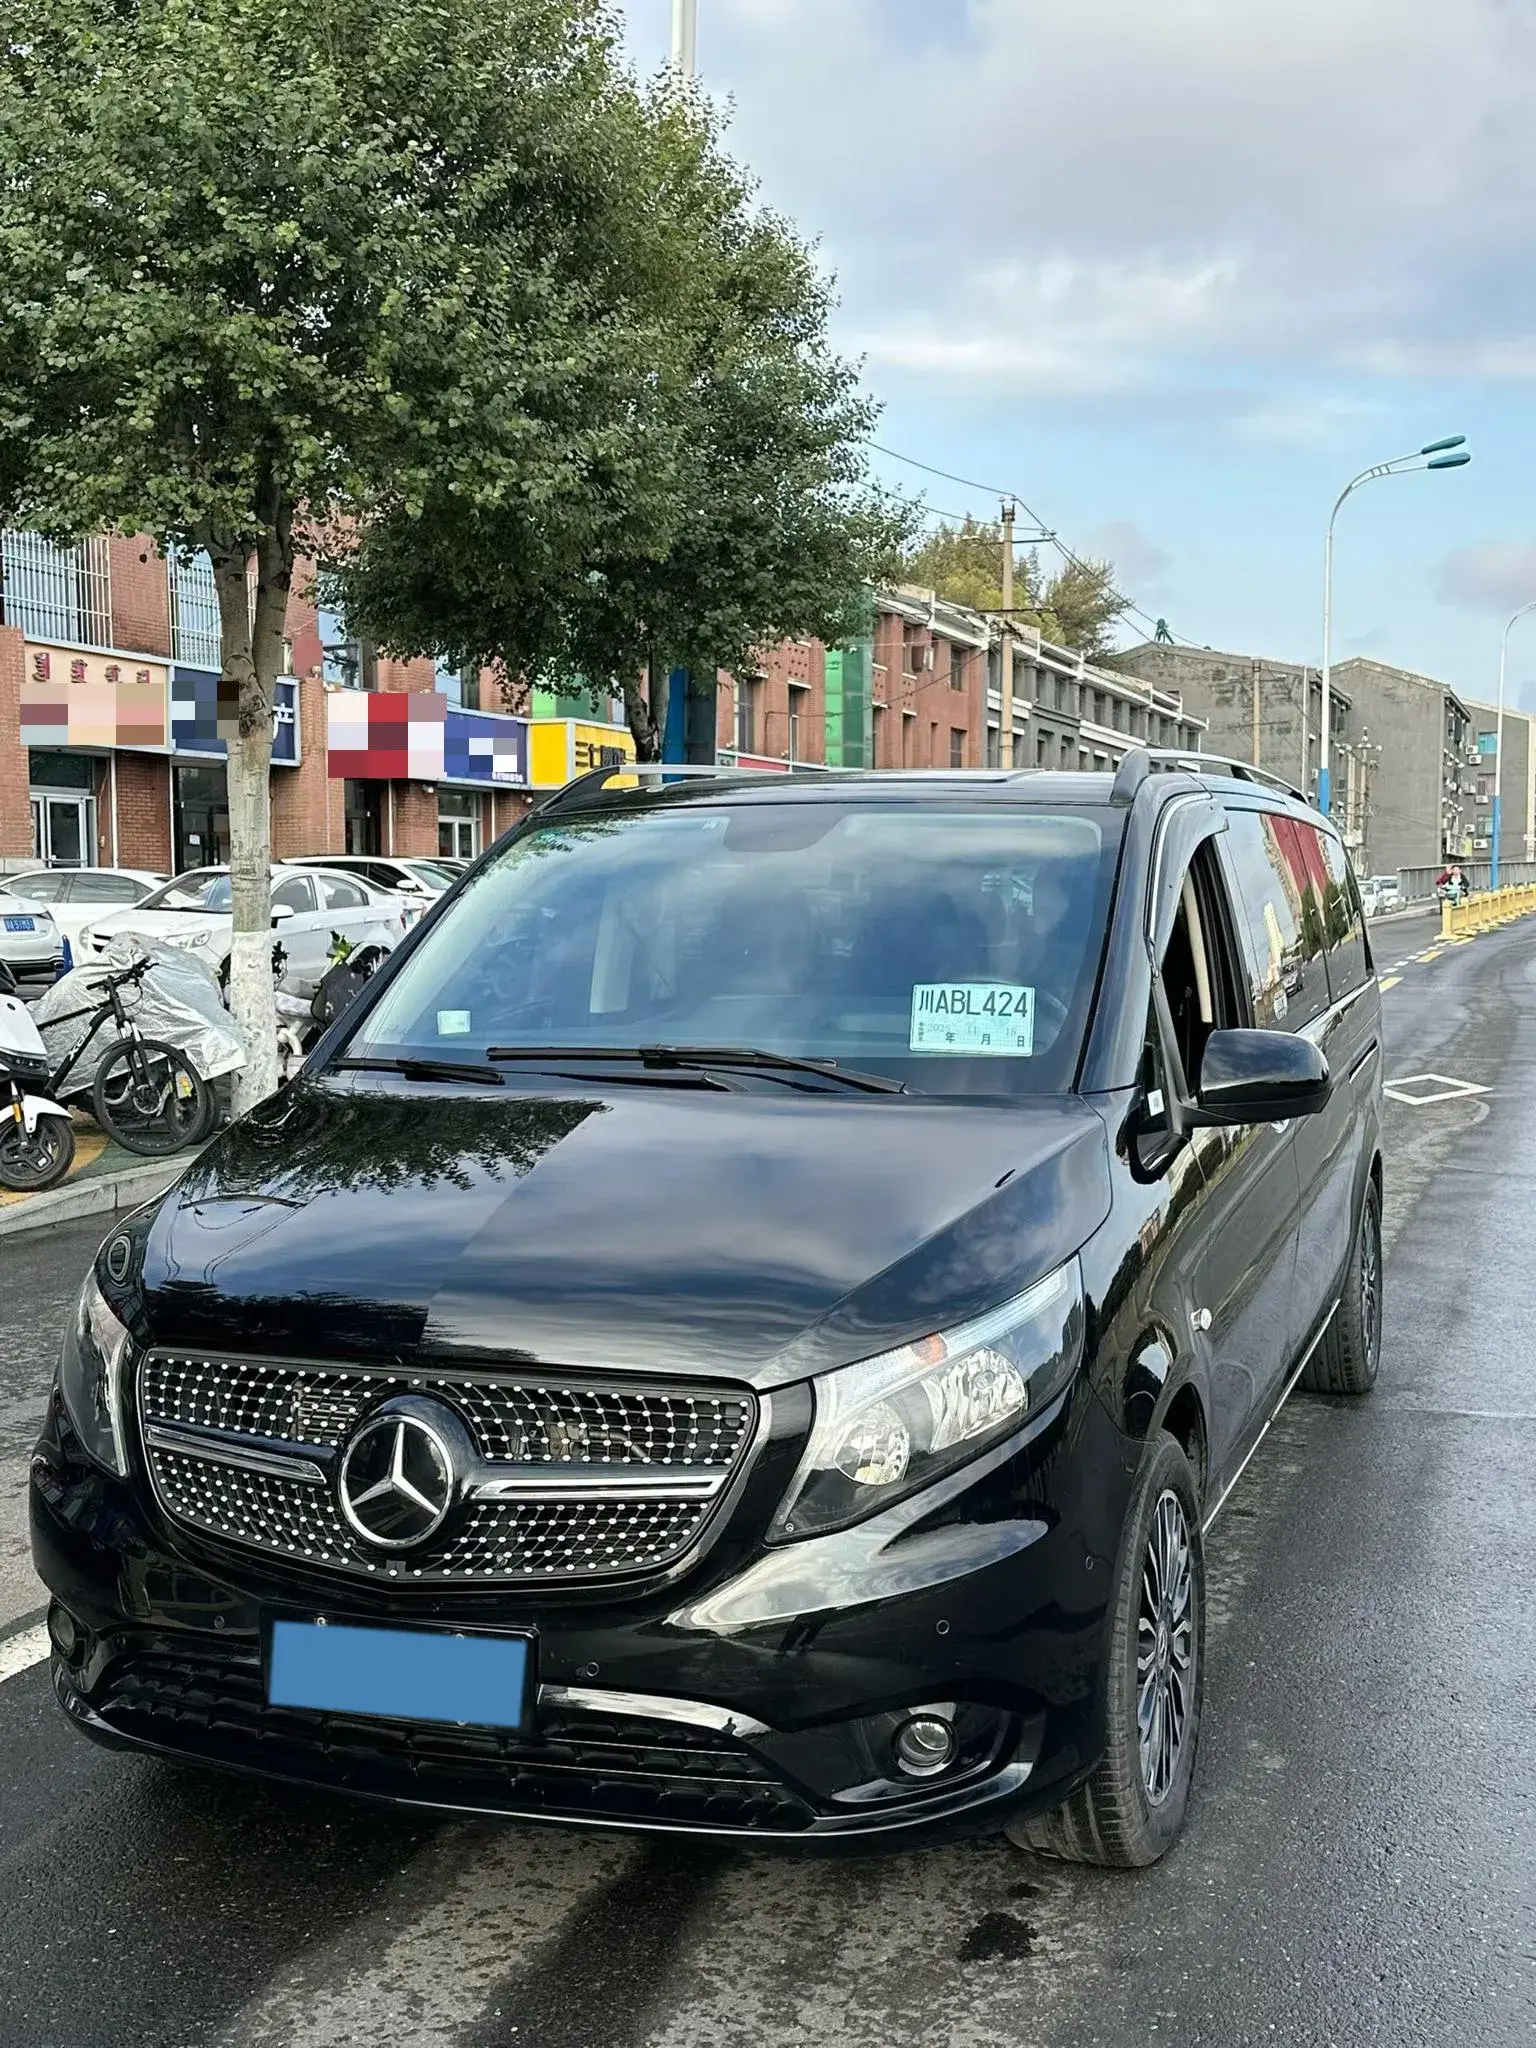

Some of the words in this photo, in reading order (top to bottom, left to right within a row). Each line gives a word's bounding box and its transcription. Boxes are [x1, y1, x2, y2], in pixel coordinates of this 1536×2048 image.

[919, 989, 1027, 1017] 川ABL424
[945, 1031, 955, 1044] 年
[981, 1033, 991, 1045] 月
[1017, 1035, 1025, 1047] 日
